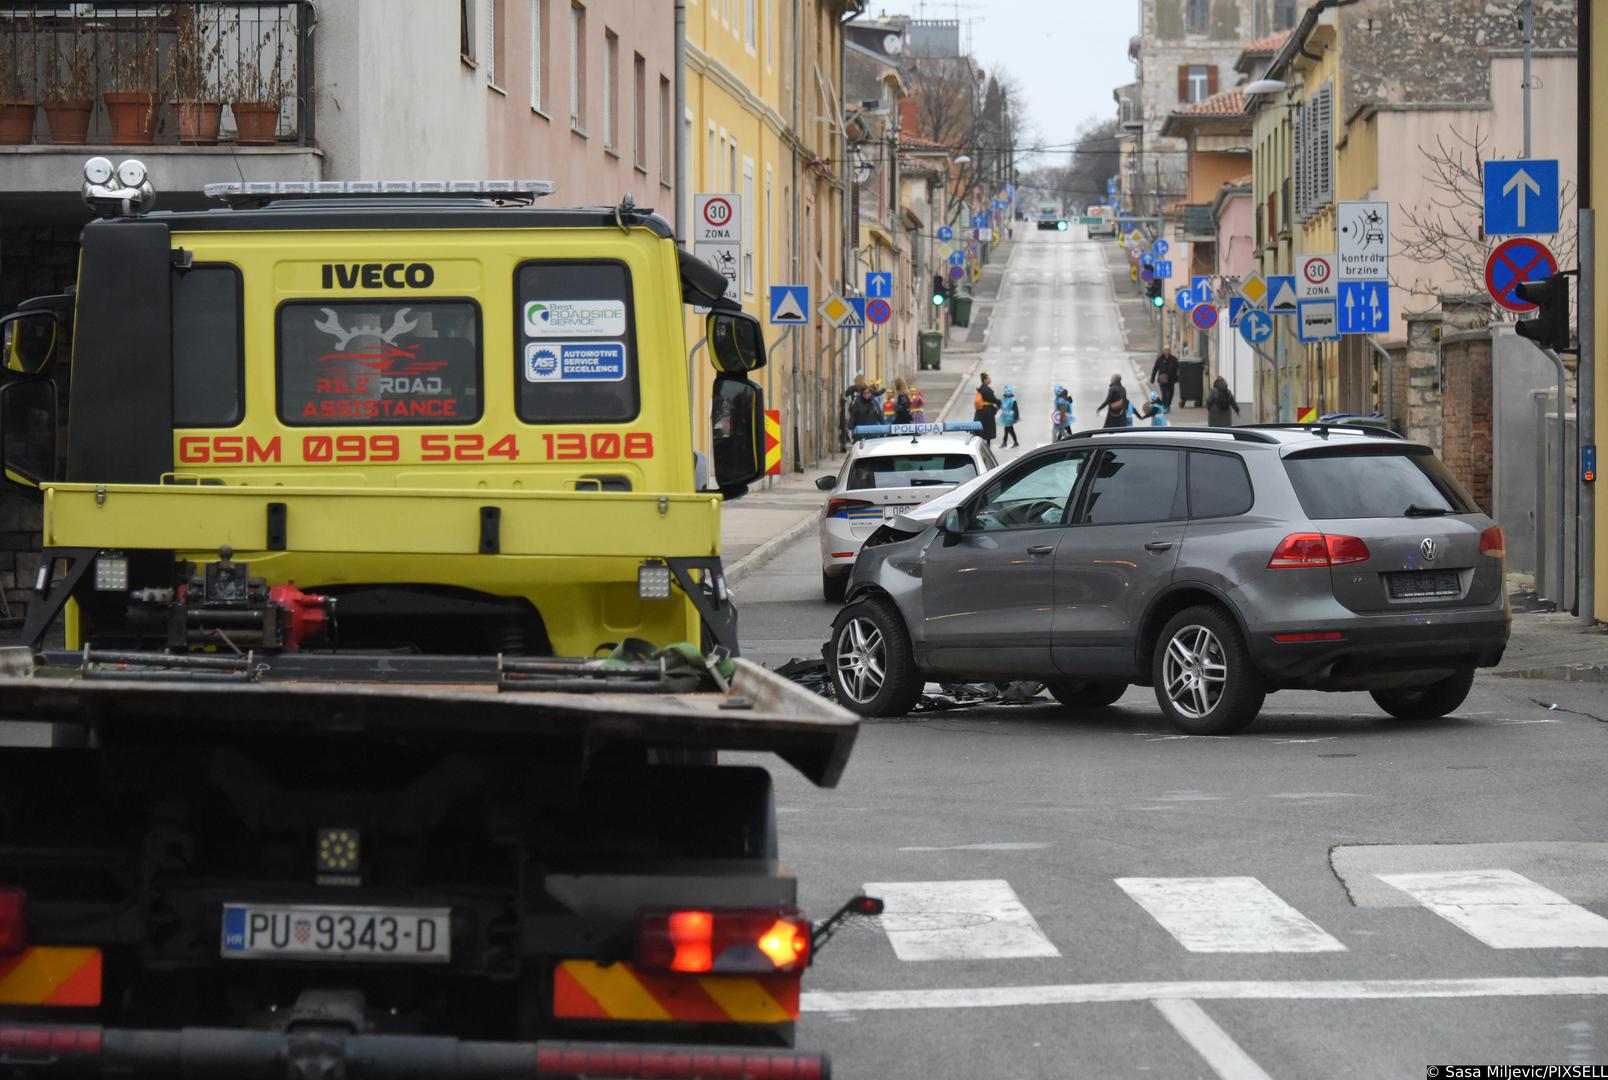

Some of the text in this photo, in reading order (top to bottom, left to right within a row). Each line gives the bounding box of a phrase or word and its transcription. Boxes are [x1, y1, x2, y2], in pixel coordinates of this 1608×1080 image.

[710, 206, 725, 219] 30
[705, 229, 730, 238] ZONA
[1342, 253, 1384, 263] kontrola
[1309, 265, 1324, 278] 30
[1345, 266, 1378, 275] brzine
[322, 263, 434, 289] IVECO
[1306, 287, 1330, 295] ZONA
[549, 303, 574, 311] Best
[550, 309, 622, 319] ROADSIDE
[550, 318, 597, 326] SERVICE
[534, 357, 554, 368] ASE
[563, 365, 618, 373] EXCELLENCE
[317, 377, 442, 394] RILE ROAD
[303, 399, 457, 417] ASSISTANCE
[894, 424, 940, 434] POLICIJA
[179, 432, 654, 463] GSM 099 524 1308
[250, 913, 436, 952] PU 9343-D
[226, 935, 243, 945] HR
